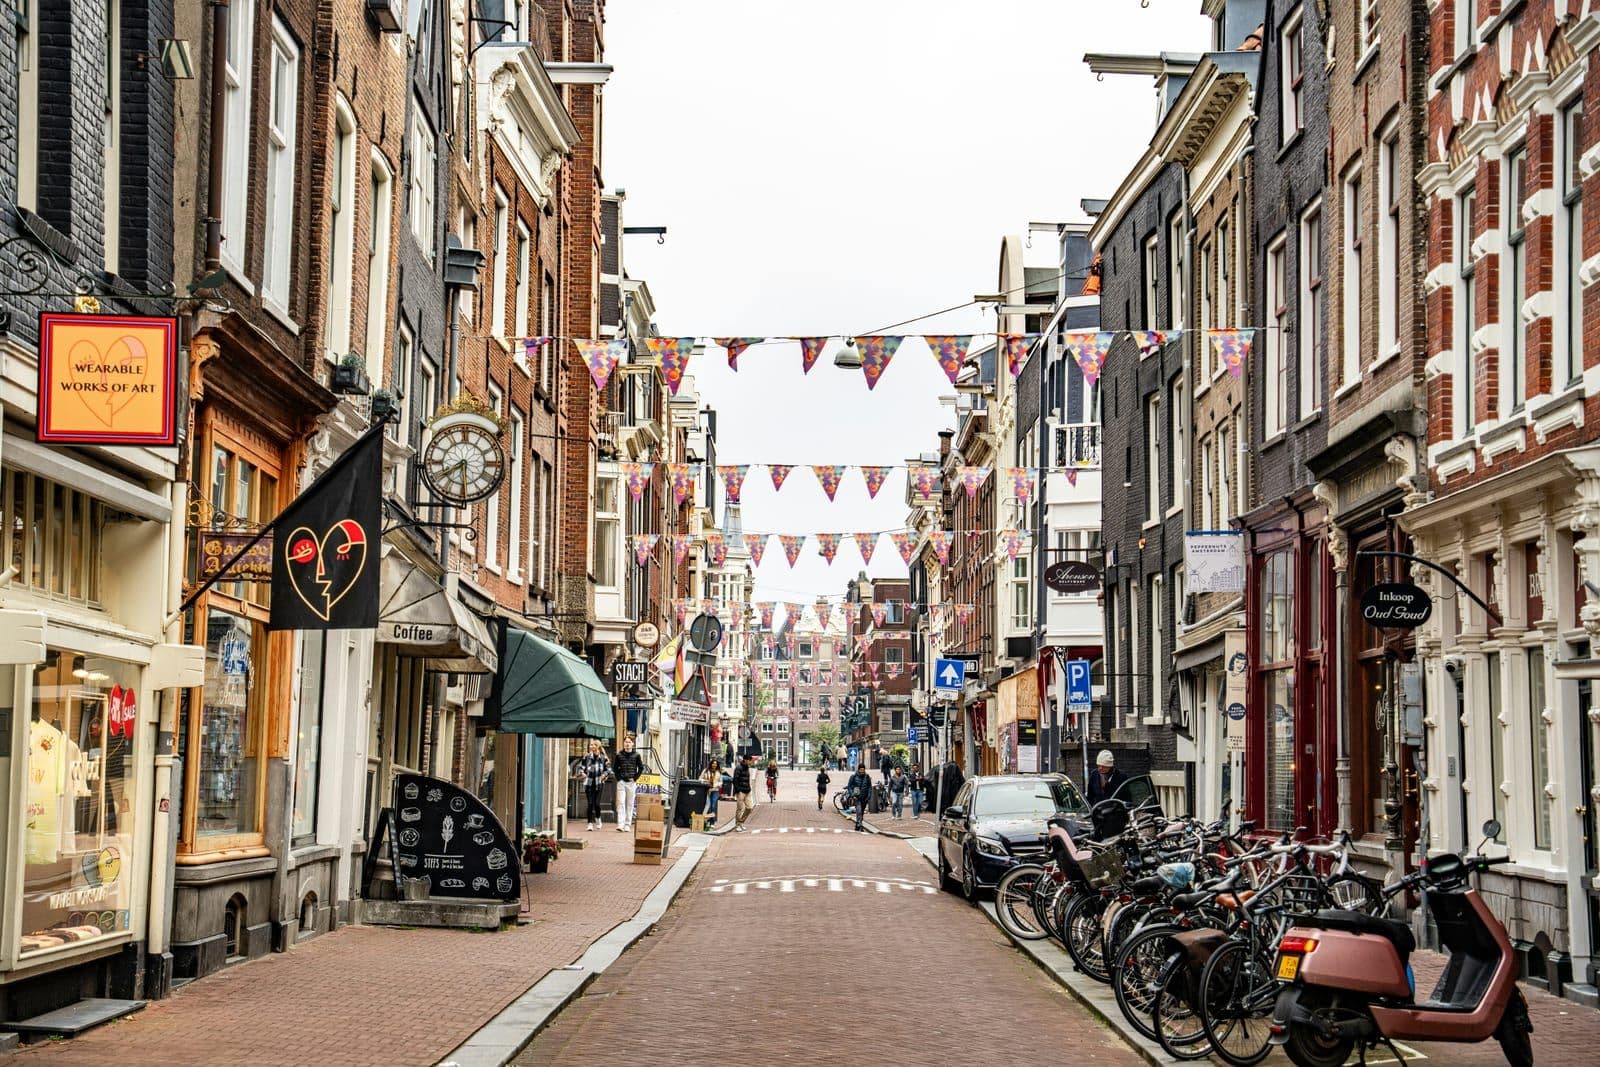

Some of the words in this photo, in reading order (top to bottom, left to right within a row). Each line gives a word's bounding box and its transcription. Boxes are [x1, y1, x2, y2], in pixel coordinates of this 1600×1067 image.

[75, 363, 143, 374] WEARABLE
[60, 382, 108, 392] WORKS
[111, 384, 129, 392] OF
[131, 384, 156, 393] ART
[1379, 591, 1414, 604] Inkoop
[1364, 605, 1394, 619] Oud
[1392, 606, 1429, 620] Goud
[393, 624, 433, 641] Coffee
[615, 663, 645, 681] STACH
[1071, 664, 1085, 687] P
[122, 704, 136, 721] SALE
[909, 729, 915, 738] P
